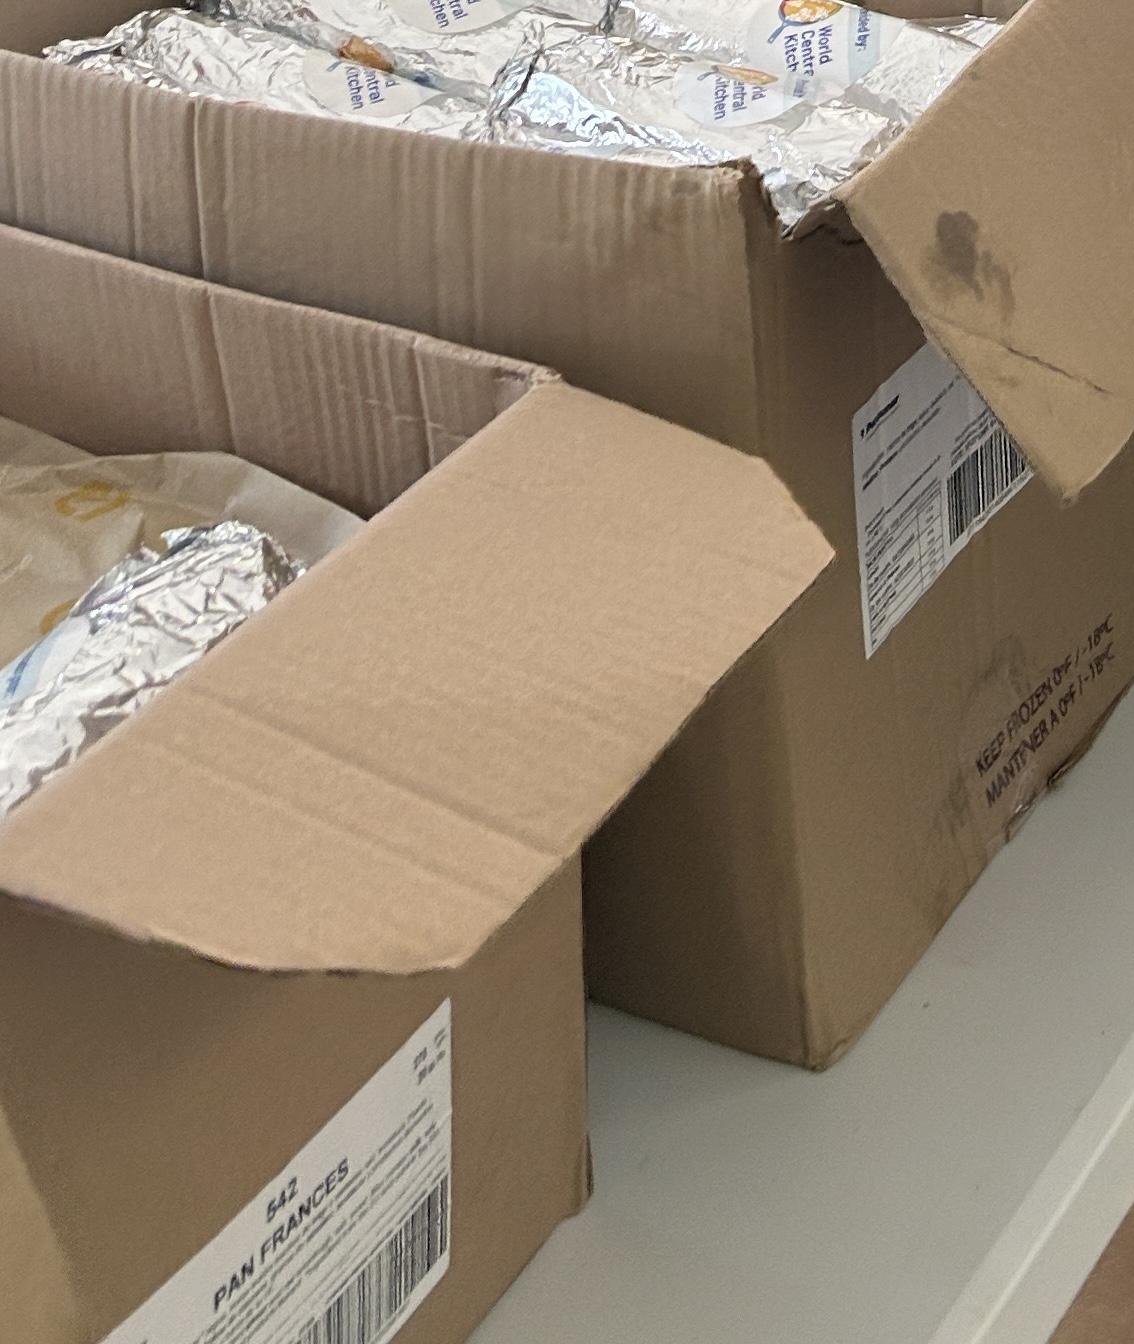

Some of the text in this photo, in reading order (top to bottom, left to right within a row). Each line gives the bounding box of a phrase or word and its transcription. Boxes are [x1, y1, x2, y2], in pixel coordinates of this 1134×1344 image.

[818, 24, 833, 66] World
[976, 730, 1005, 777] KEEP
[1007, 677, 1053, 738] FROZEN
[986, 719, 1050, 808] MANTENER
[1050, 709, 1060, 733] A
[213, 1255, 254, 1313] PAN
[259, 1158, 350, 1266] FRANCES
